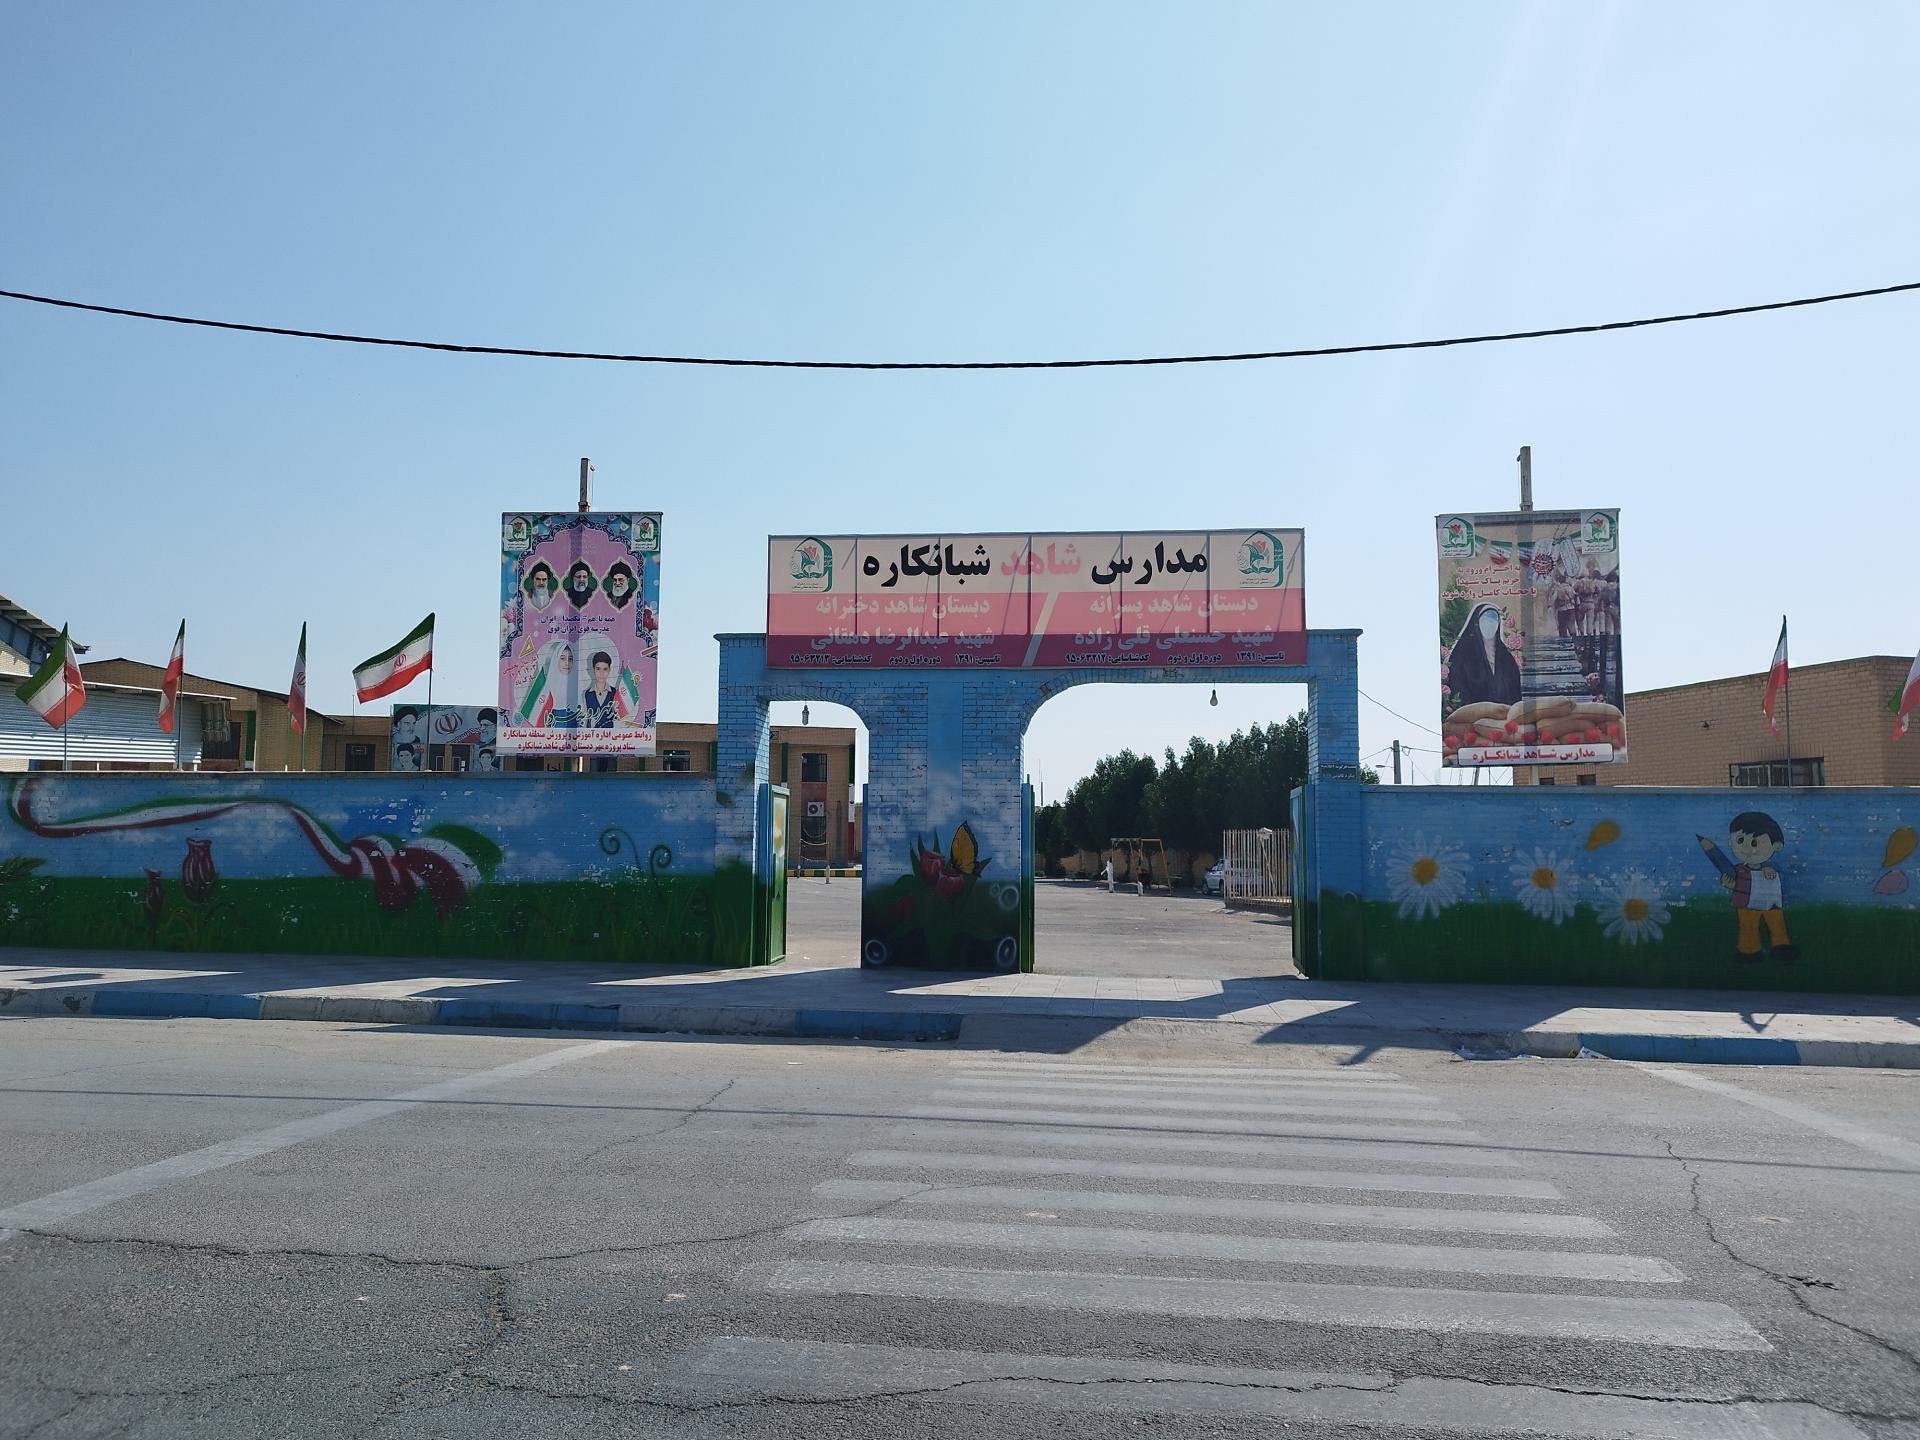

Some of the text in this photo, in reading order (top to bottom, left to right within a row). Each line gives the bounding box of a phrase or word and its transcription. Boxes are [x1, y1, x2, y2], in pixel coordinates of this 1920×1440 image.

[863, 541, 1208, 588] مدارس شاهد شبانکاره
[1502, 576, 1520, 585] حریم
[1441, 589, 1460, 600] شوید
[1461, 589, 1476, 599] وارد
[1478, 588, 1501, 598] کامل
[1502, 587, 1529, 596] حجاب
[816, 595, 990, 621] دبستان شاهد دخترانه
[1089, 592, 1259, 618] دبستان شاهد پسرانه
[810, 625, 996, 652] شهید عبدالرضا دهقانی
[1074, 625, 1275, 651] شهید حسنعلی قلی زاده
[888, 654, 942, 666] دوره اول و دوم
[955, 653, 974, 664] ۱۳۹۱
[1167, 652, 1222, 665] دوره اول و دوم
[1236, 650, 1256, 661] ۱۳۹۱
[503, 729, 528, 740] شبانکاره
[528, 730, 546, 738] منطقه
[572, 729, 595, 741] آموزش
[595, 730, 611, 741] اداره
[611, 731, 634, 741] عمومی
[634, 730, 652, 741] روابط
[518, 741, 543, 751] شبانکاره
[543, 741, 558, 750] شاهد
[558, 741, 572, 751] های
[572, 742, 593, 752] دبستان
[1472, 748, 1597, 763] مدارس شاهد شبانکاره
